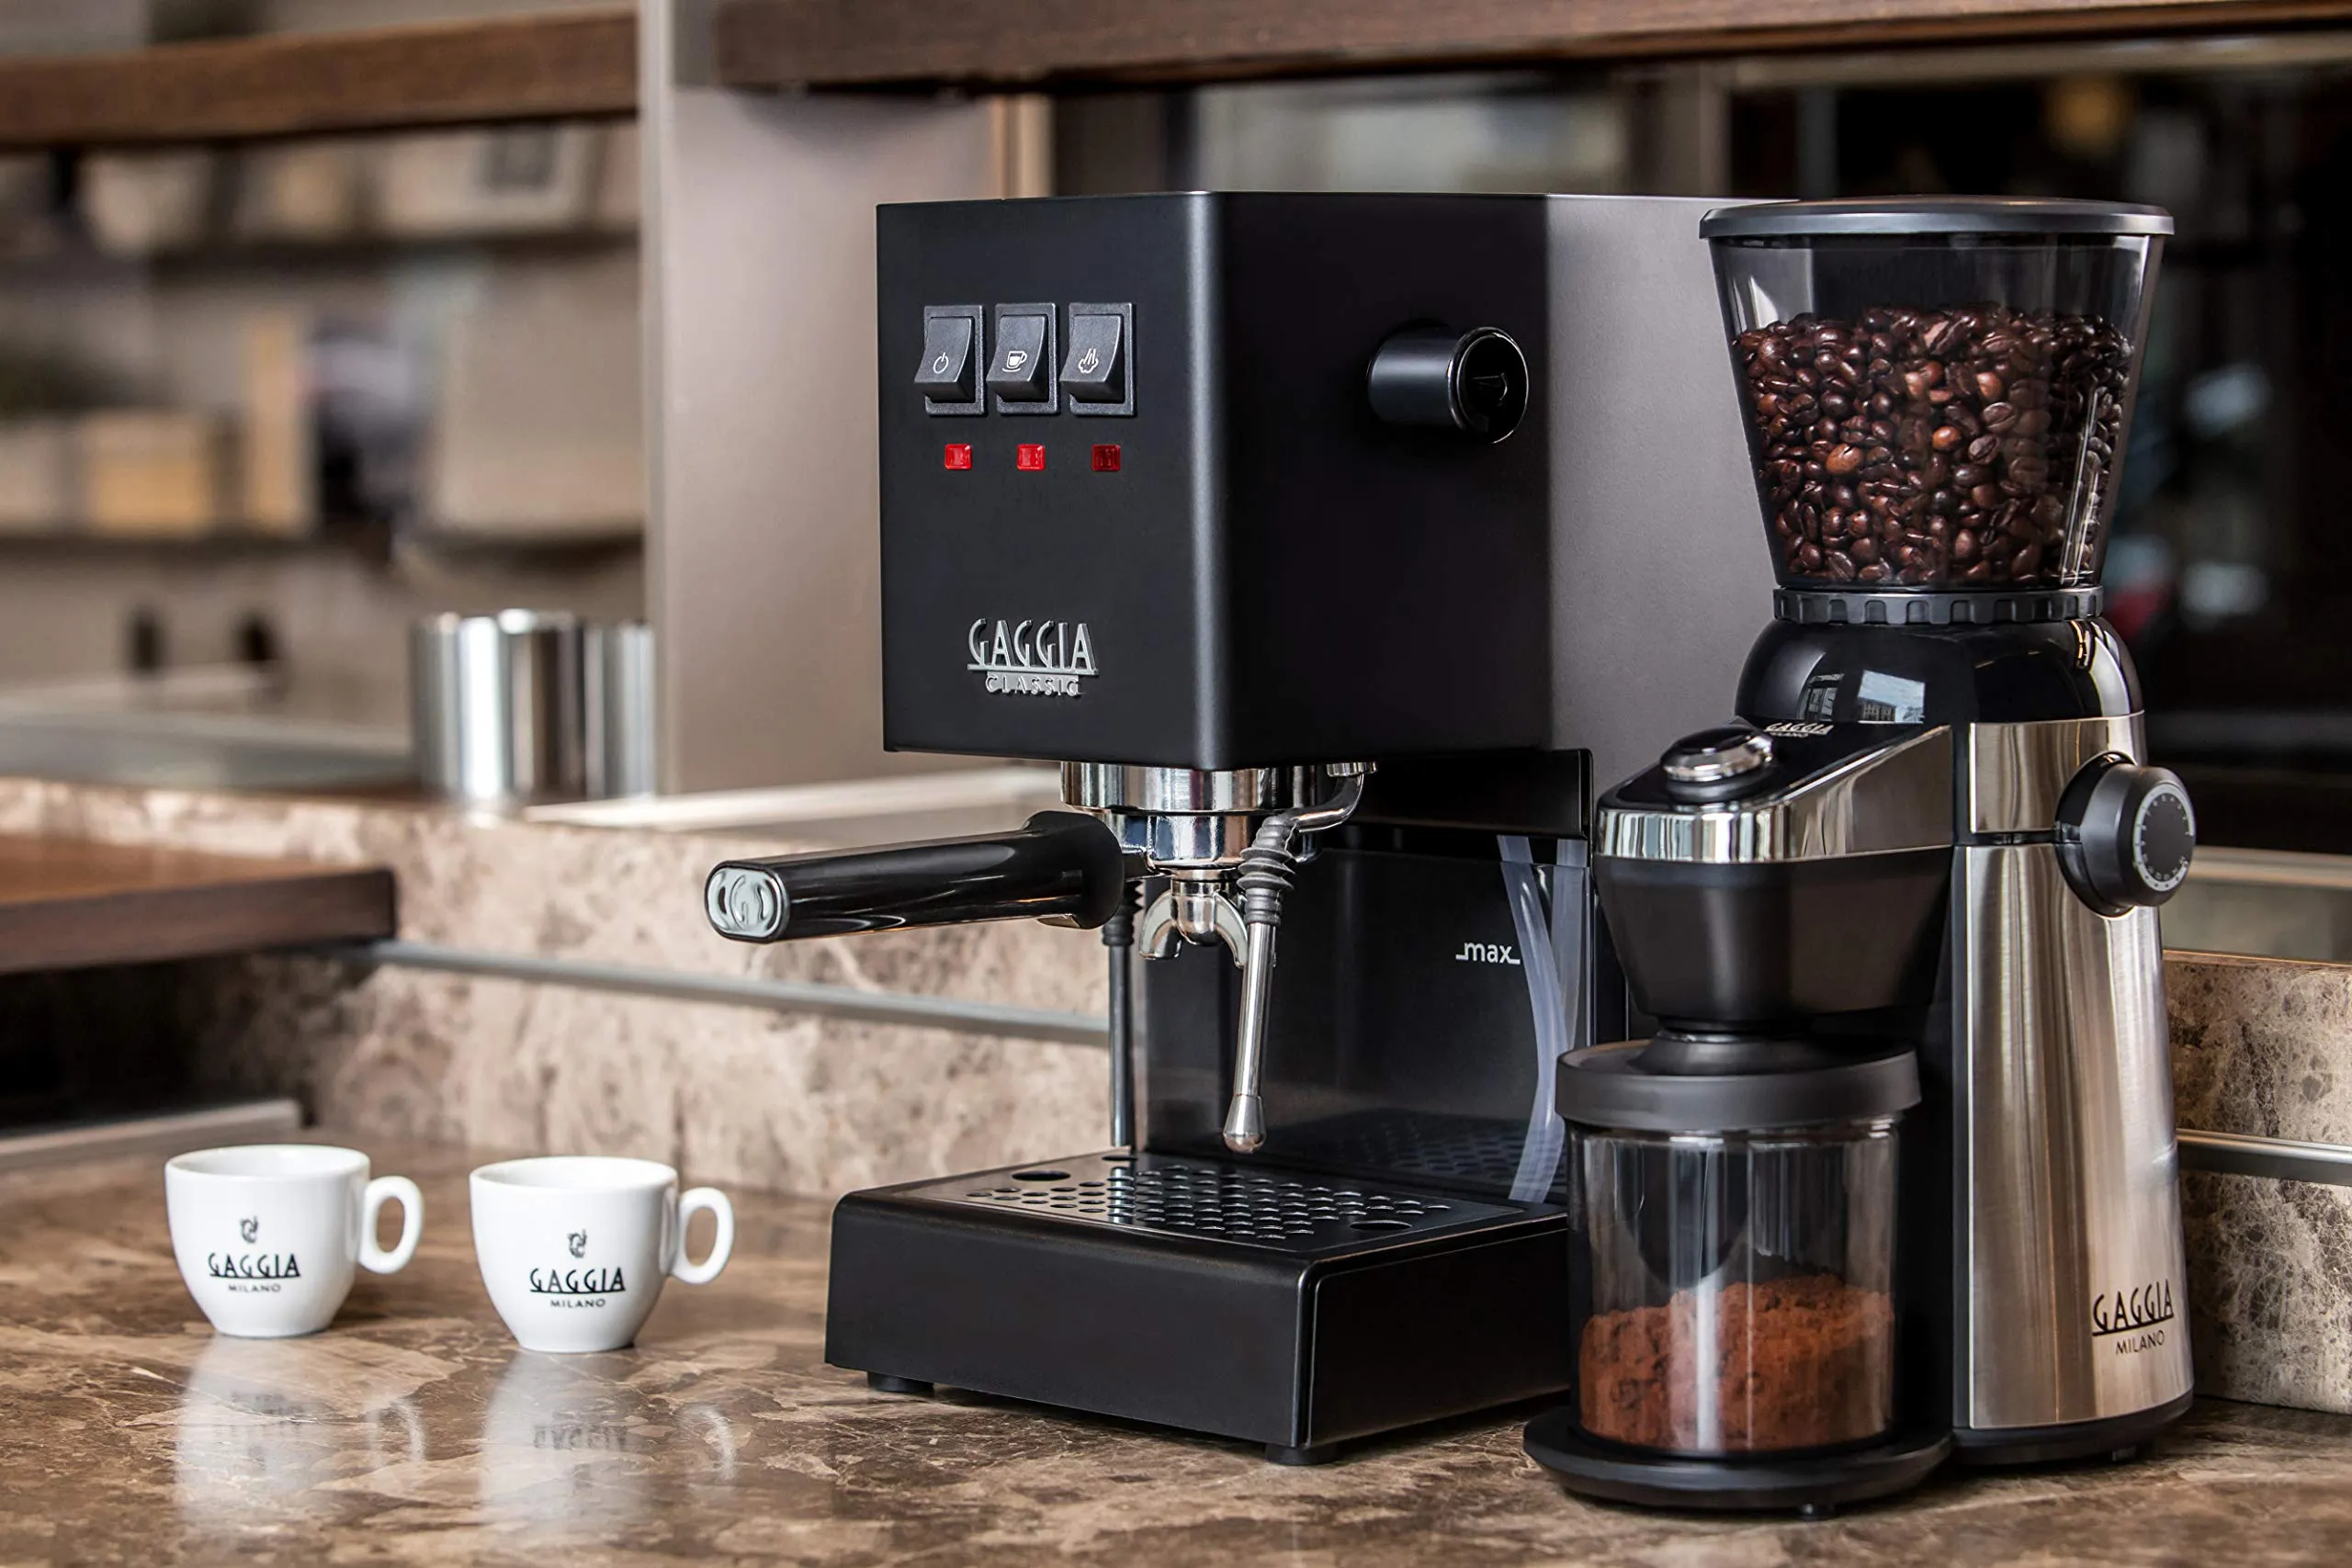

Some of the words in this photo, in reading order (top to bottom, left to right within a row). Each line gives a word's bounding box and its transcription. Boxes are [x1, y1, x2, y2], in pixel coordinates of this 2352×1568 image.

[967, 618, 1099, 675] GAGGIA
[985, 673, 1081, 697] CLASSIC
[1763, 722, 1835, 735] GAGGIA
[1463, 942, 1513, 964] max
[208, 1252, 301, 1280] GAGGIA
[228, 1283, 281, 1293] MILANO
[529, 1267, 626, 1294] GAGGIA
[550, 1298, 606, 1308] MILANO
[2092, 1278, 2175, 1337] GAGGIA
[2115, 1329, 2165, 1356] MILANO
